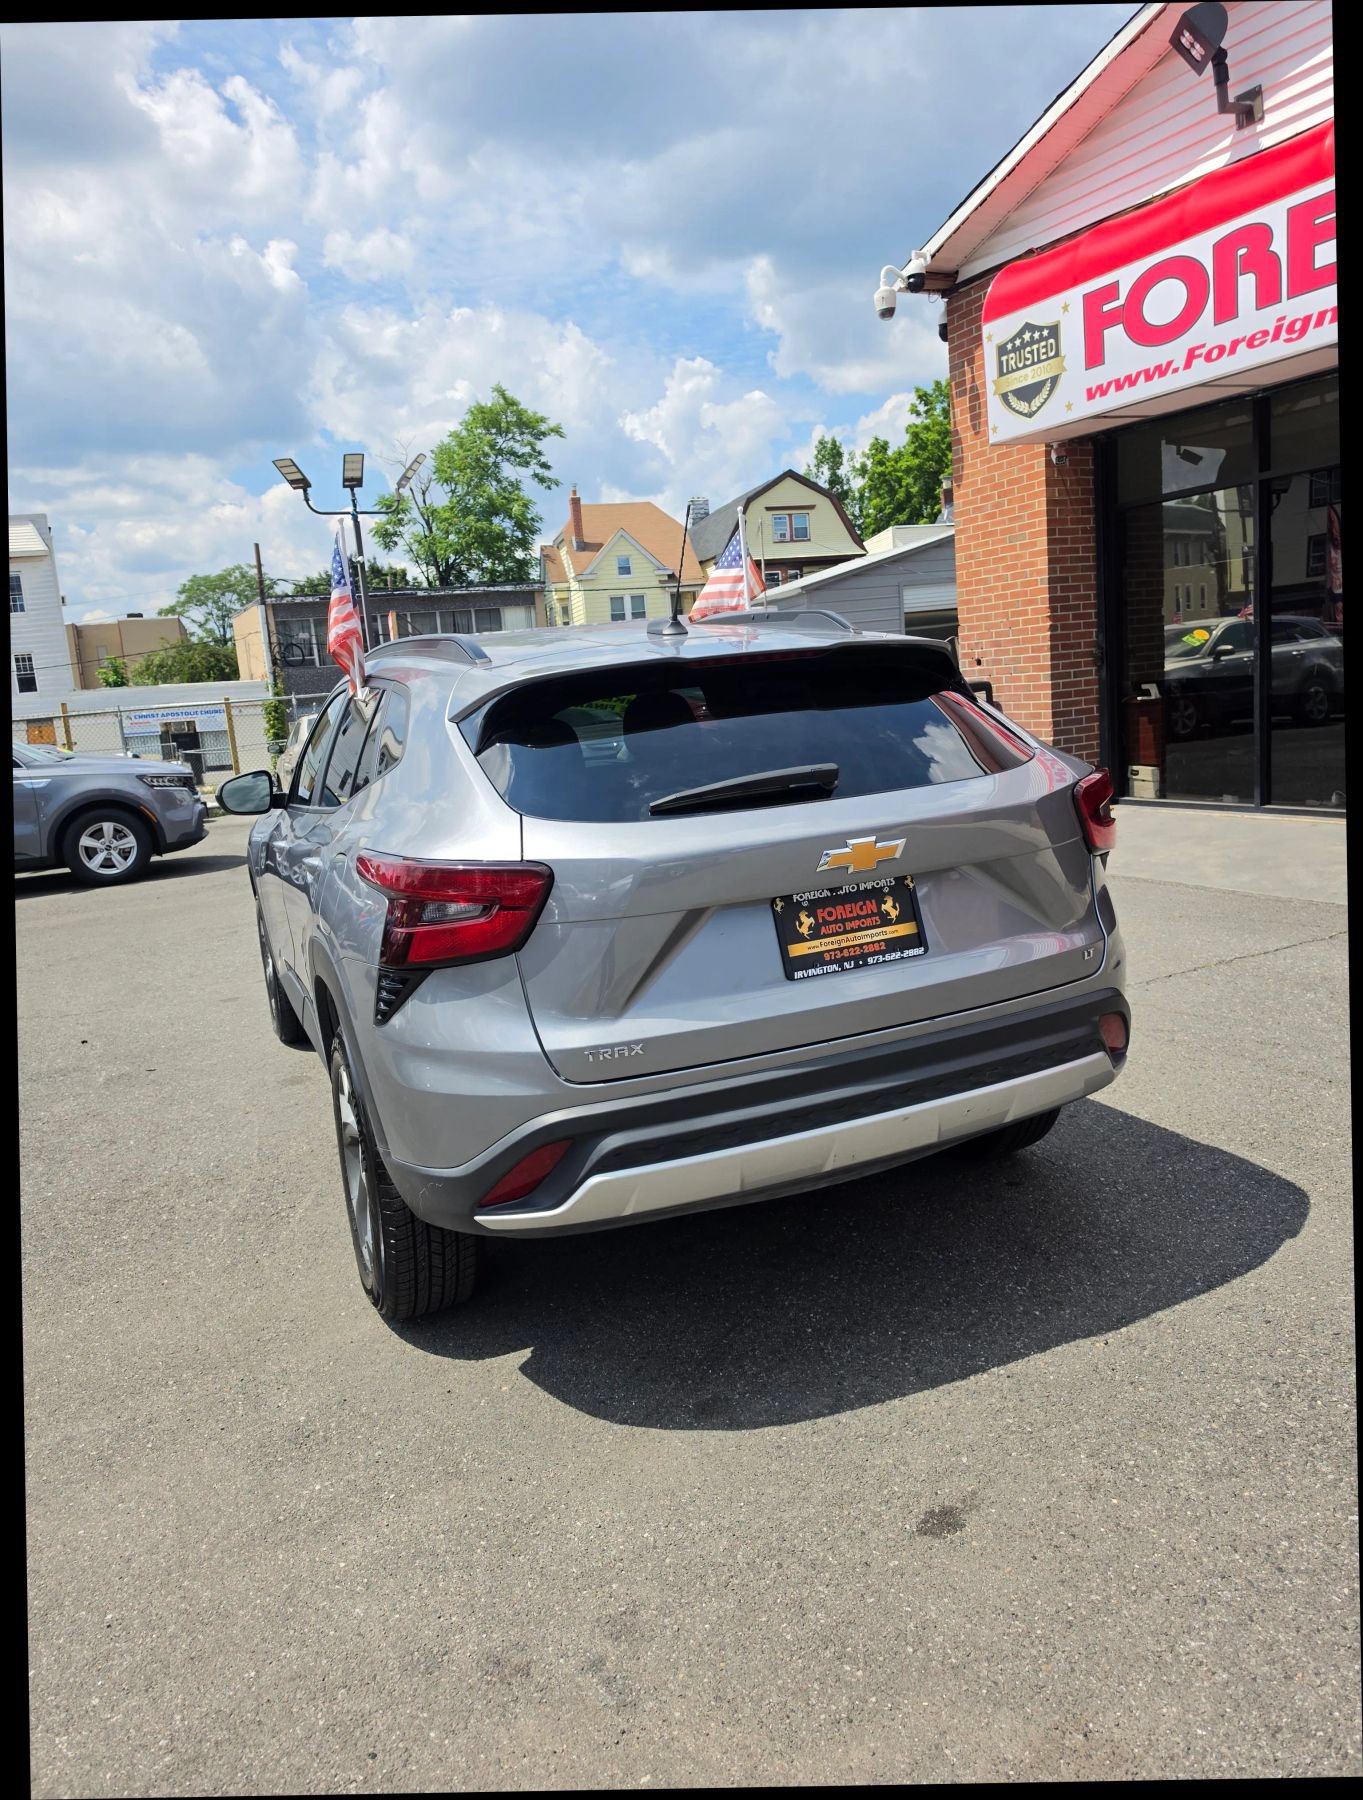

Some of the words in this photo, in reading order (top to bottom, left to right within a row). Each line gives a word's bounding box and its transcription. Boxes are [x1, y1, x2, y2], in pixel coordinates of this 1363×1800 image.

[1001, 338, 1056, 373] TRUSTED
[1031, 363, 1052, 379] 2010
[161, 710, 199, 718] APOSTOLIC
[793, 889, 831, 902] FOREIGN
[832, 884, 857, 896] UTO
[859, 877, 895, 890] IMPORTS
[816, 900, 878, 923] FOREIGN
[820, 923, 844, 935] AUTO
[845, 916, 881, 930] IMPORTS
[823, 941, 886, 961] 973-622-2882
[794, 964, 842, 980] IRVINGTON,
[844, 960, 855, 969] NJ
[867, 947, 925, 965] 973-622-2882
[584, 1043, 644, 1062] TRAX
